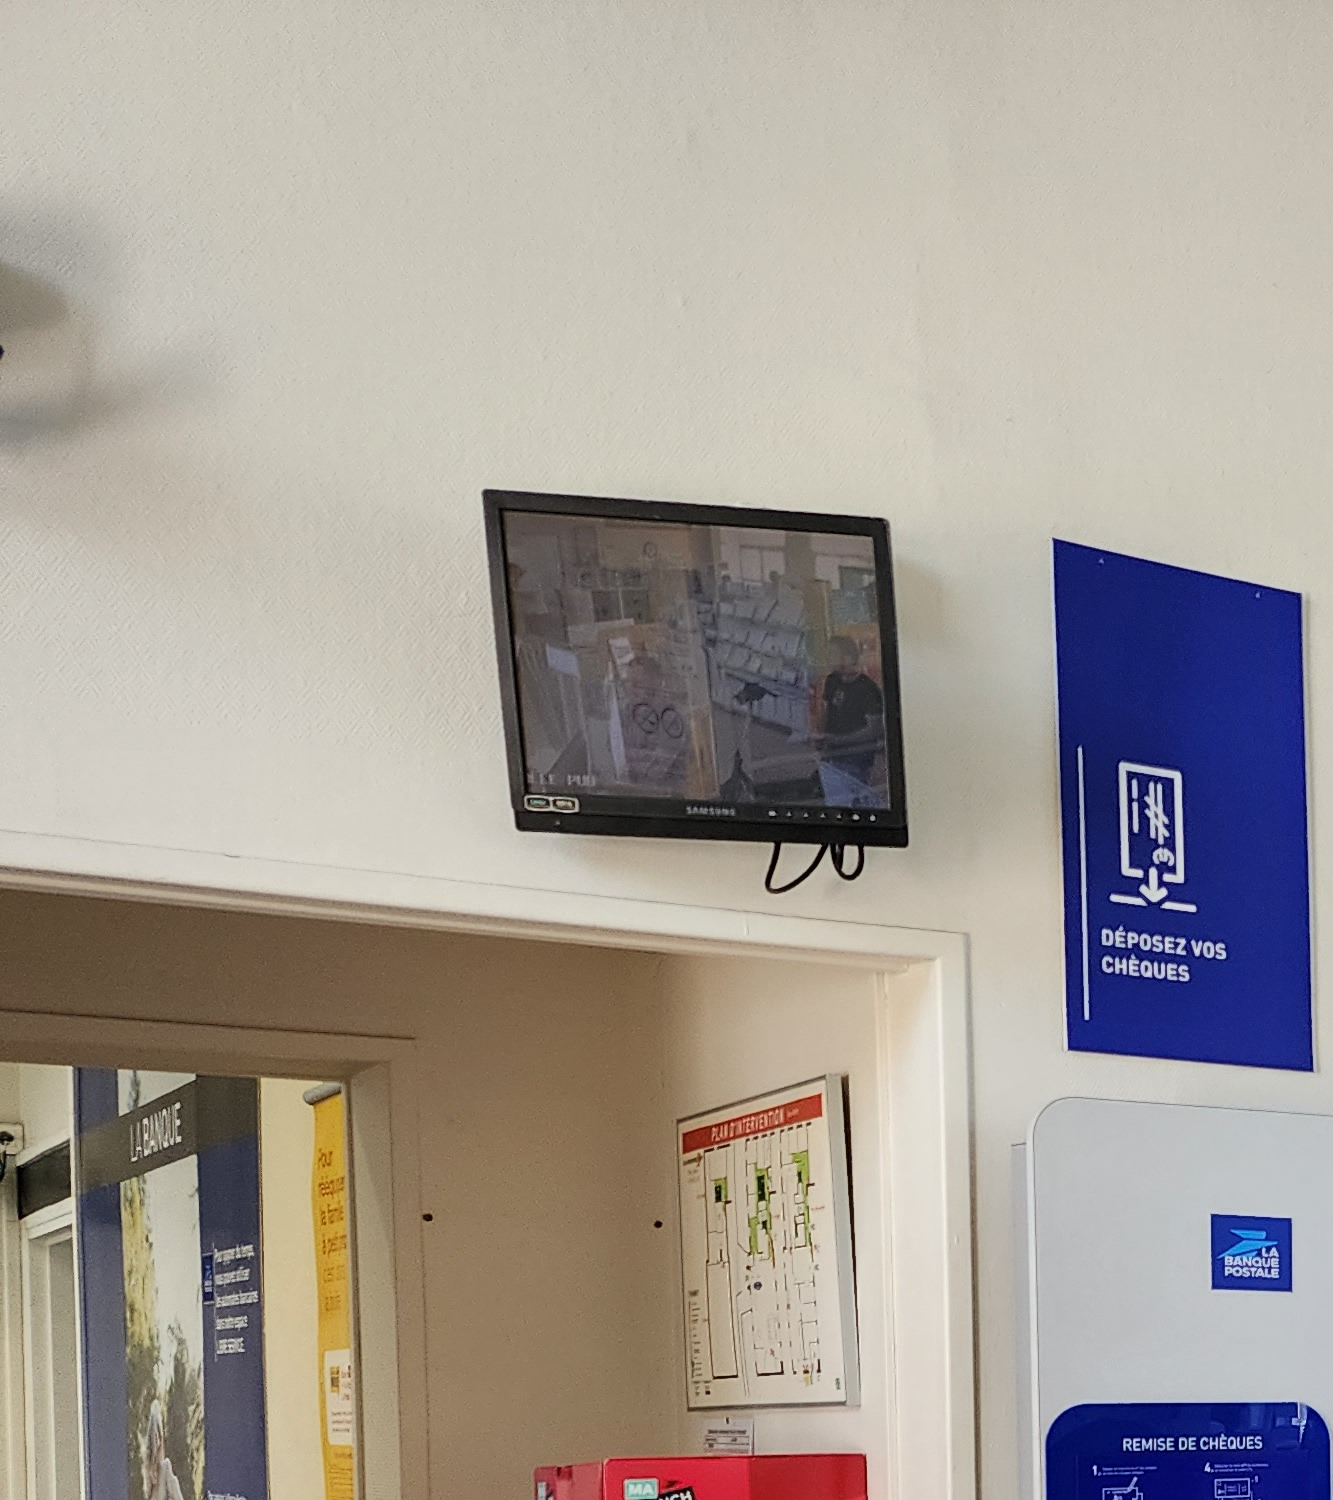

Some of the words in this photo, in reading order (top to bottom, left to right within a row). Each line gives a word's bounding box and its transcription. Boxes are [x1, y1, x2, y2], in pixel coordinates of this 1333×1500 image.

[1101, 925, 1187, 956] DÉPOSEZ
[1190, 939, 1228, 960] VOS
[1101, 953, 1190, 982] CHÈQUES
[142, 1101, 183, 1158] BANQUE
[710, 1123, 729, 1142] PLAN
[1122, 1437, 1175, 1452] REMISE
[1178, 1436, 1198, 1450] DE
[1200, 1433, 1264, 1450] CHÈQUES
